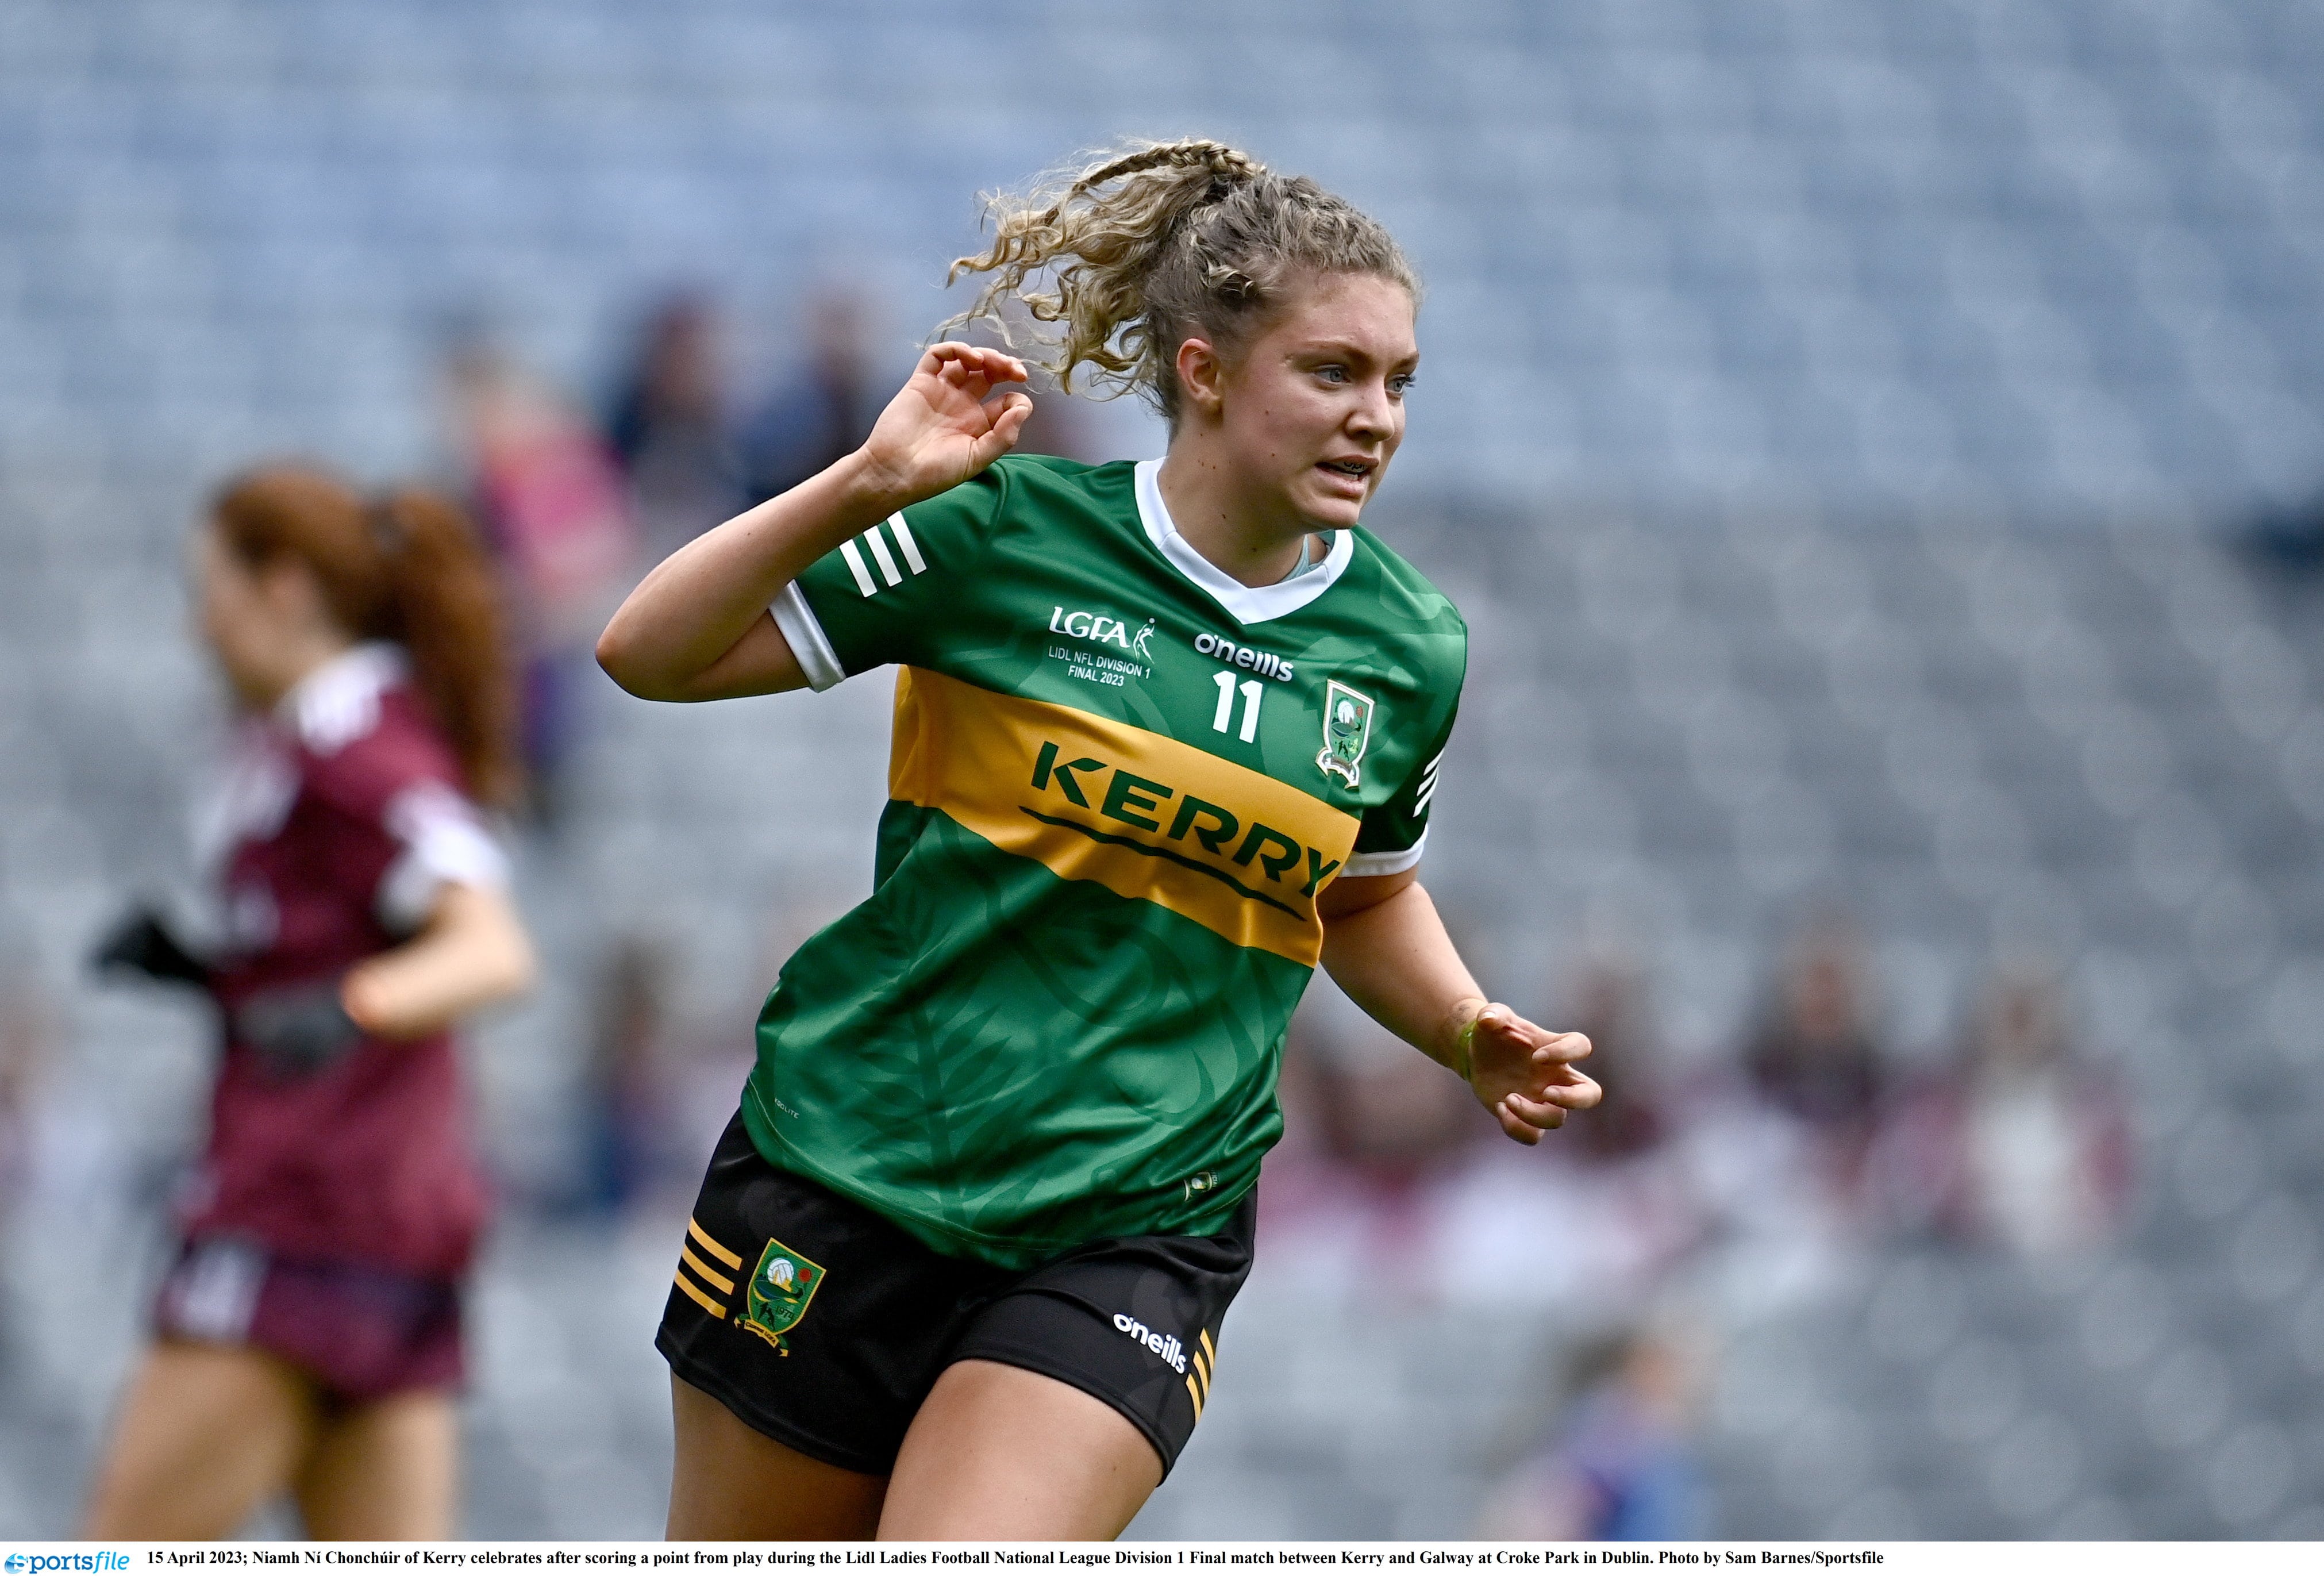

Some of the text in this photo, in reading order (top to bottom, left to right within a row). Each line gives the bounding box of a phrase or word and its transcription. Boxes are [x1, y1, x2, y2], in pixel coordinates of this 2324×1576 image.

[1049, 606, 1131, 648] LGFA
[1048, 645, 1151, 679] LIDL NFL DIVISION 1
[1068, 664, 1125, 687] FINAL 2023
[1194, 633, 1294, 682] o'neills
[1213, 670, 1263, 744] 11
[1030, 740, 1340, 898] KERRY
[775, 1306, 794, 1321] 1974
[1113, 1313, 1186, 1374] o'neills
